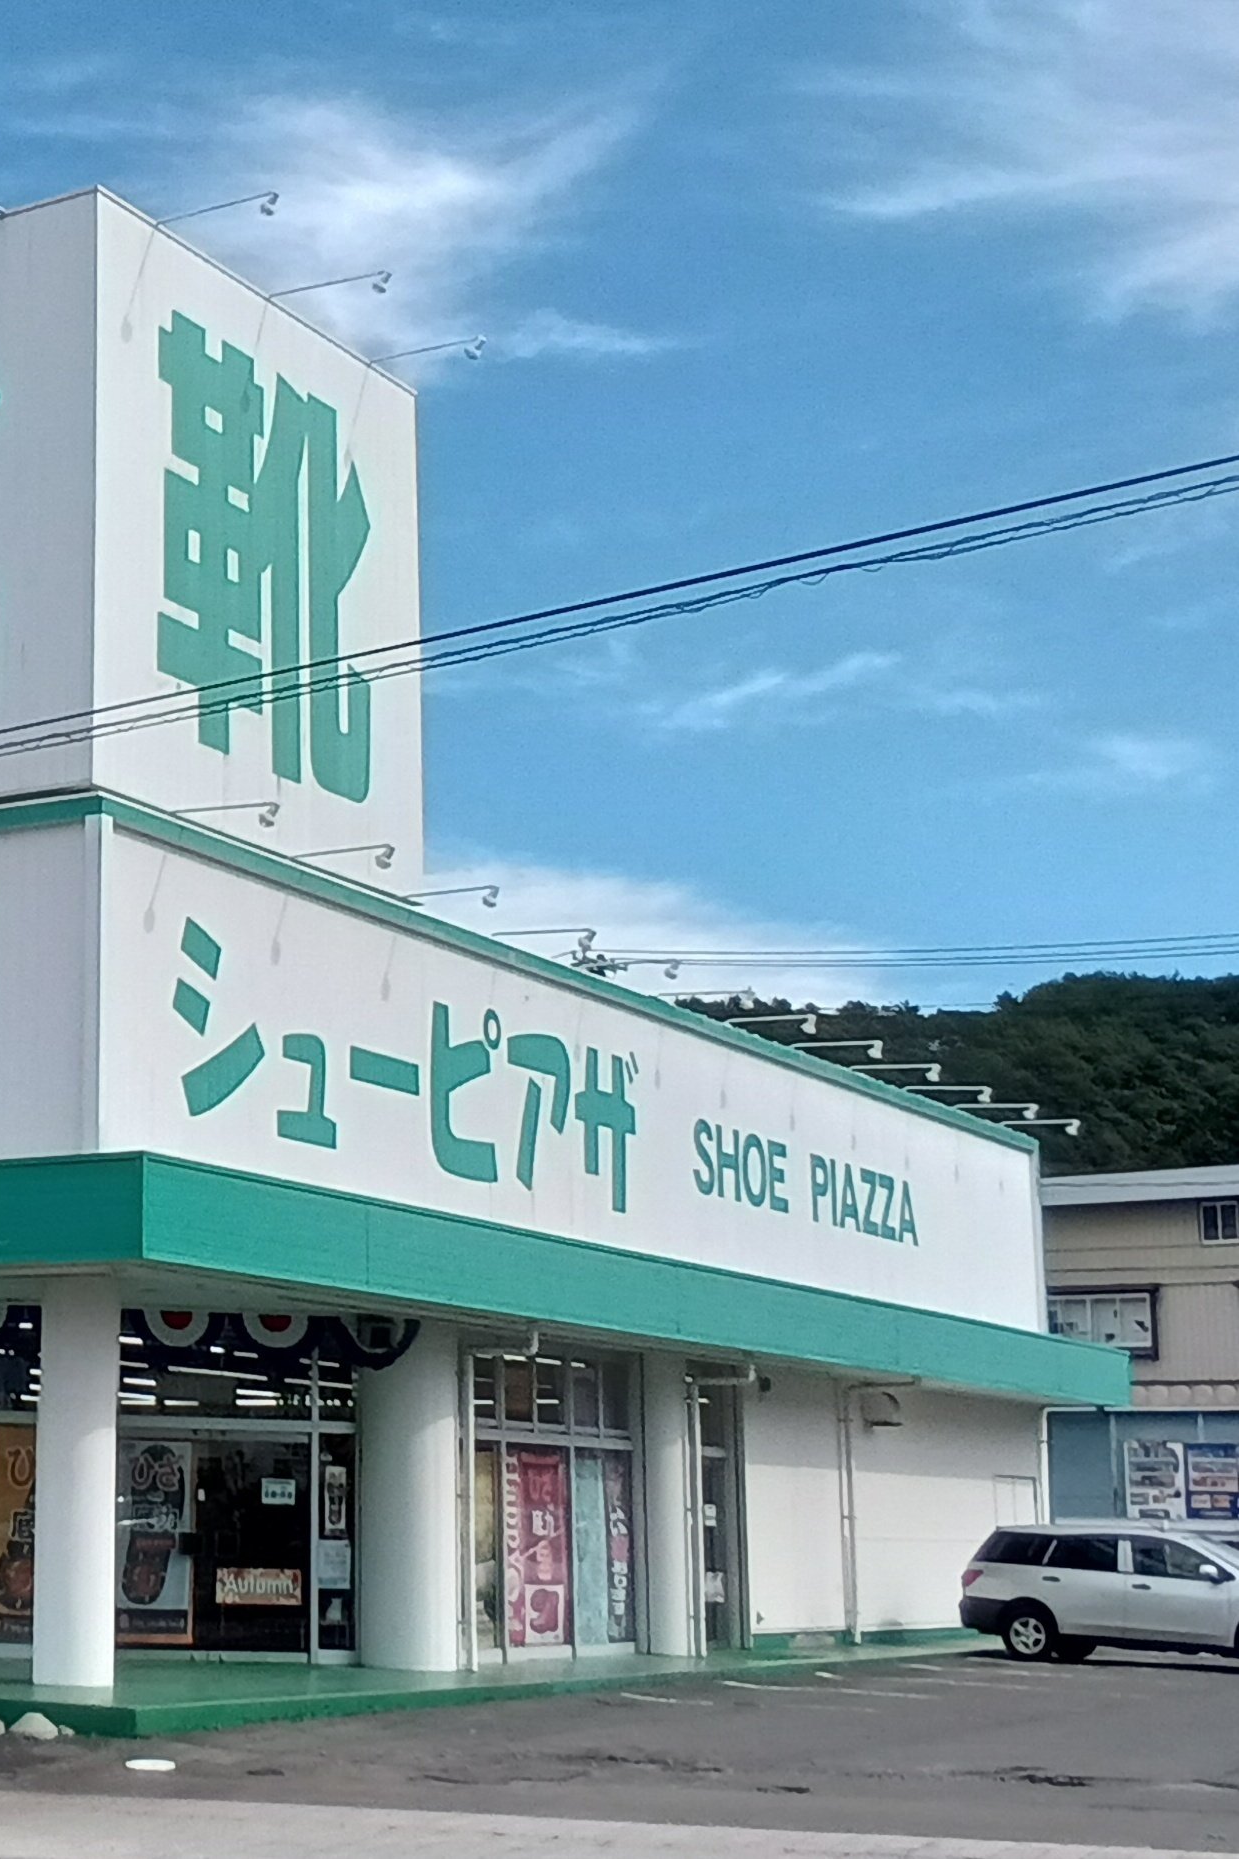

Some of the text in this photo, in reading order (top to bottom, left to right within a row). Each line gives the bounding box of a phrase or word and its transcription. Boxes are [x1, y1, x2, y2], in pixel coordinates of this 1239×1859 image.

[157, 311, 372, 804] 靴
[173, 917, 638, 1213] シューピアザ
[692, 1118, 920, 1247] SHOE PIAZZA
